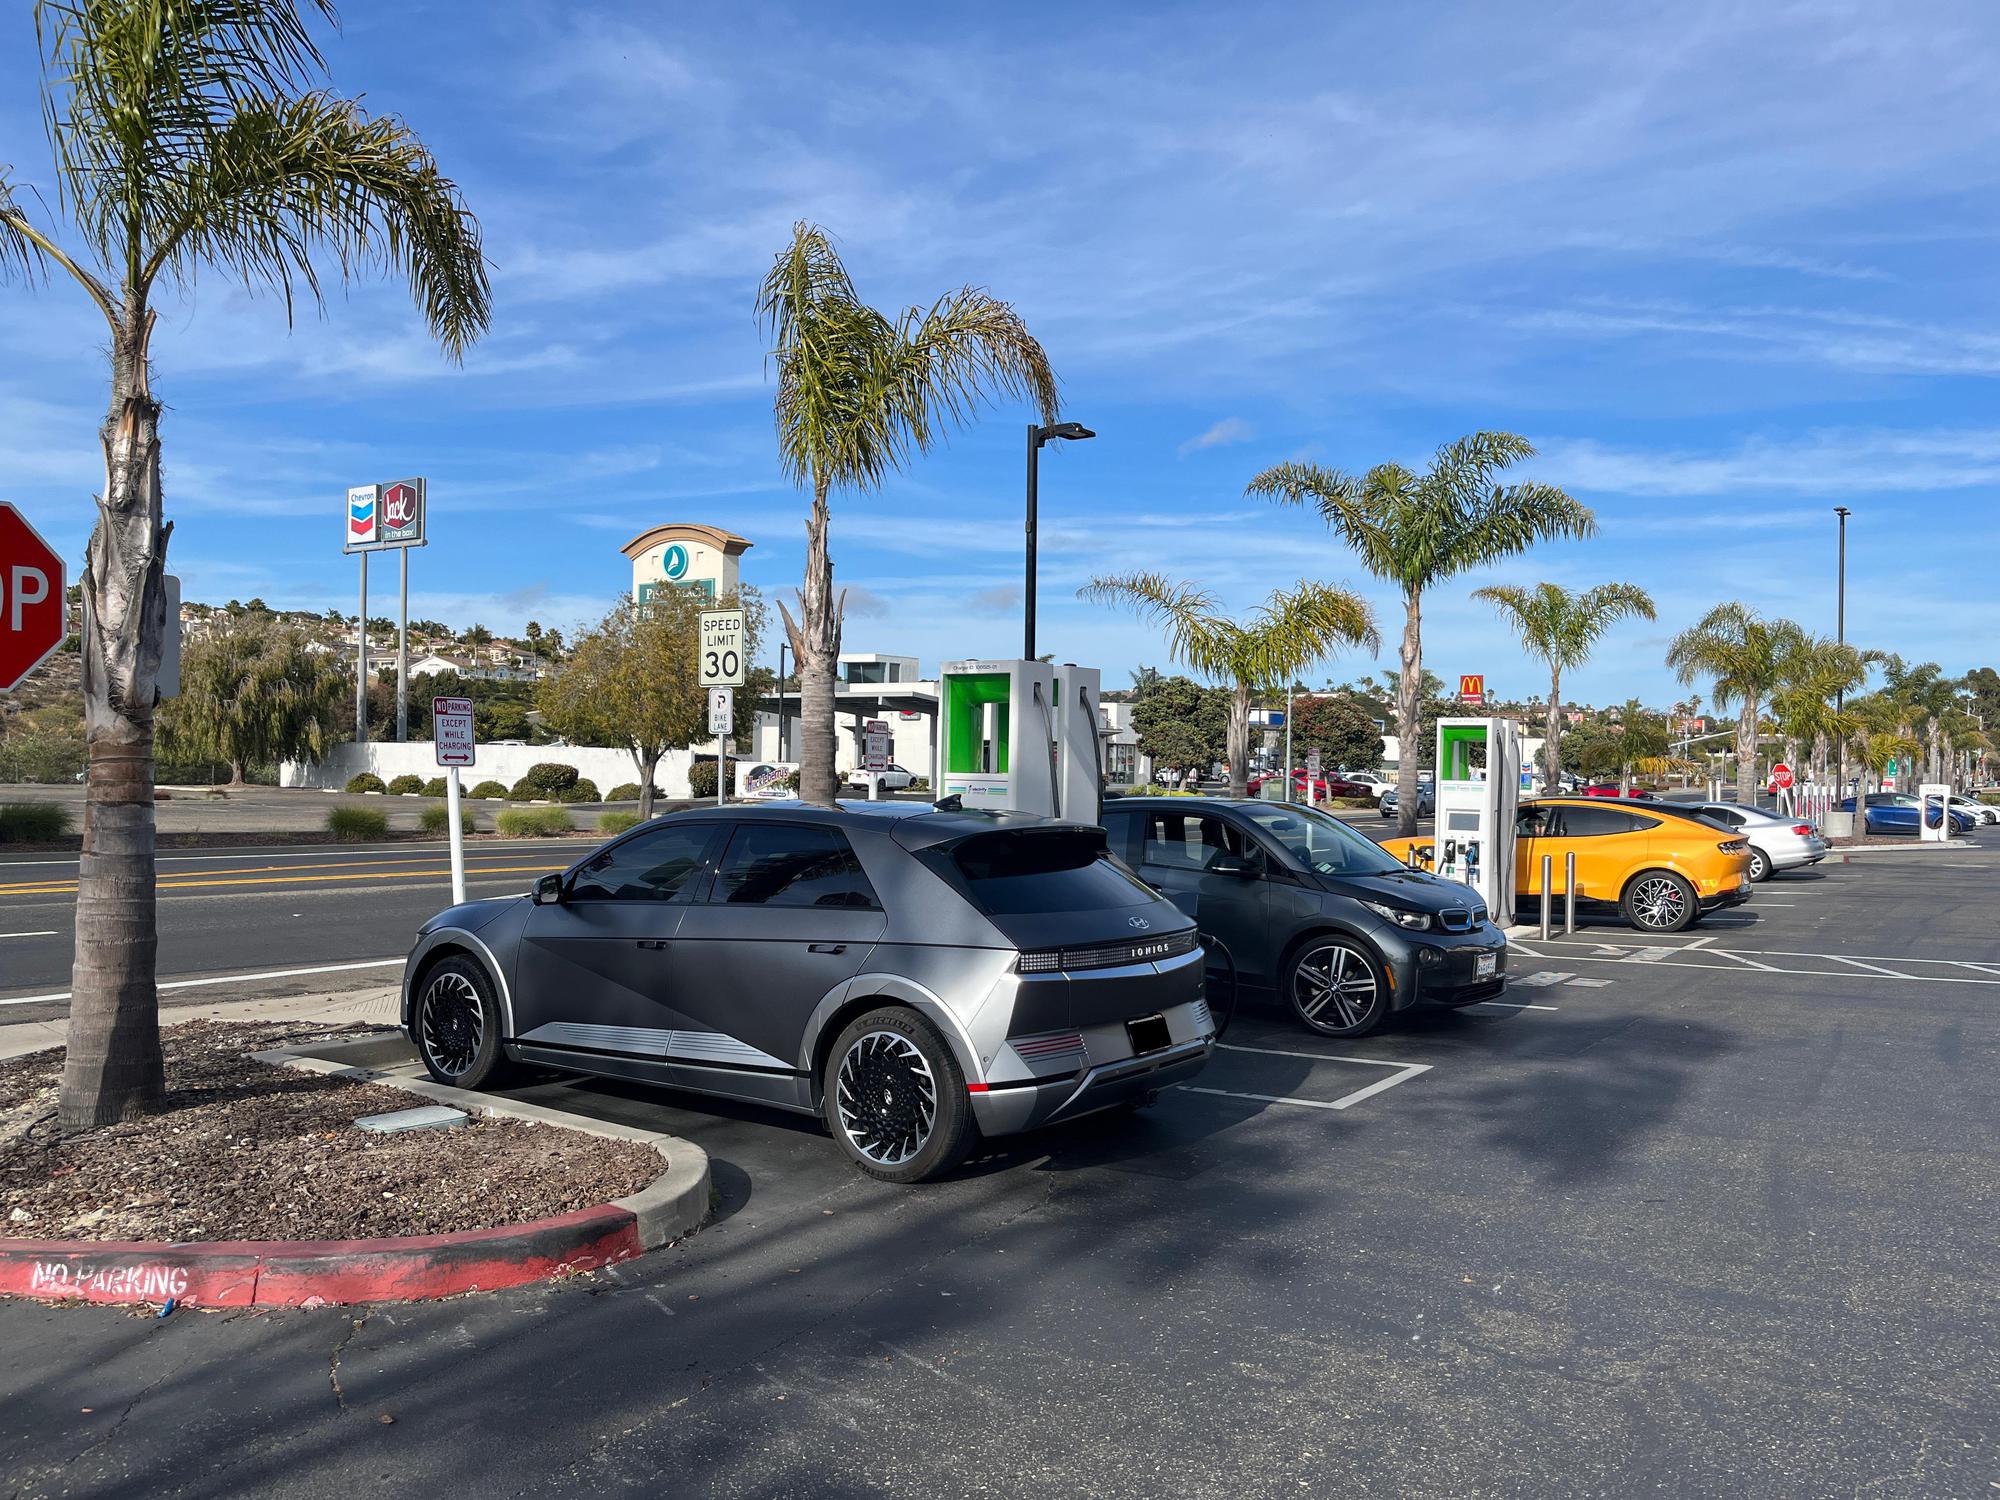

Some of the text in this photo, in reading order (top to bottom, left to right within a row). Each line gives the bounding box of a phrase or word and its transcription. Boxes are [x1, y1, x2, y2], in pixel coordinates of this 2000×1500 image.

[351, 493, 374, 502] Chevron
[384, 488, 415, 523] Jack
[385, 528, 414, 539] in the box
[703, 618, 741, 632] SPEED
[707, 634, 736, 647] LIMIT
[704, 650, 739, 678] 30
[436, 700, 470, 712] NO PARKING
[714, 713, 727, 722] BIKE
[441, 719, 467, 728] EXCEPT
[713, 723, 728, 731] LANE
[444, 731, 465, 739] WHILE
[439, 741, 472, 751] CHARGING
[1775, 771, 1791, 782] STOP
[32, 1261, 188, 1296] NO PARKING
